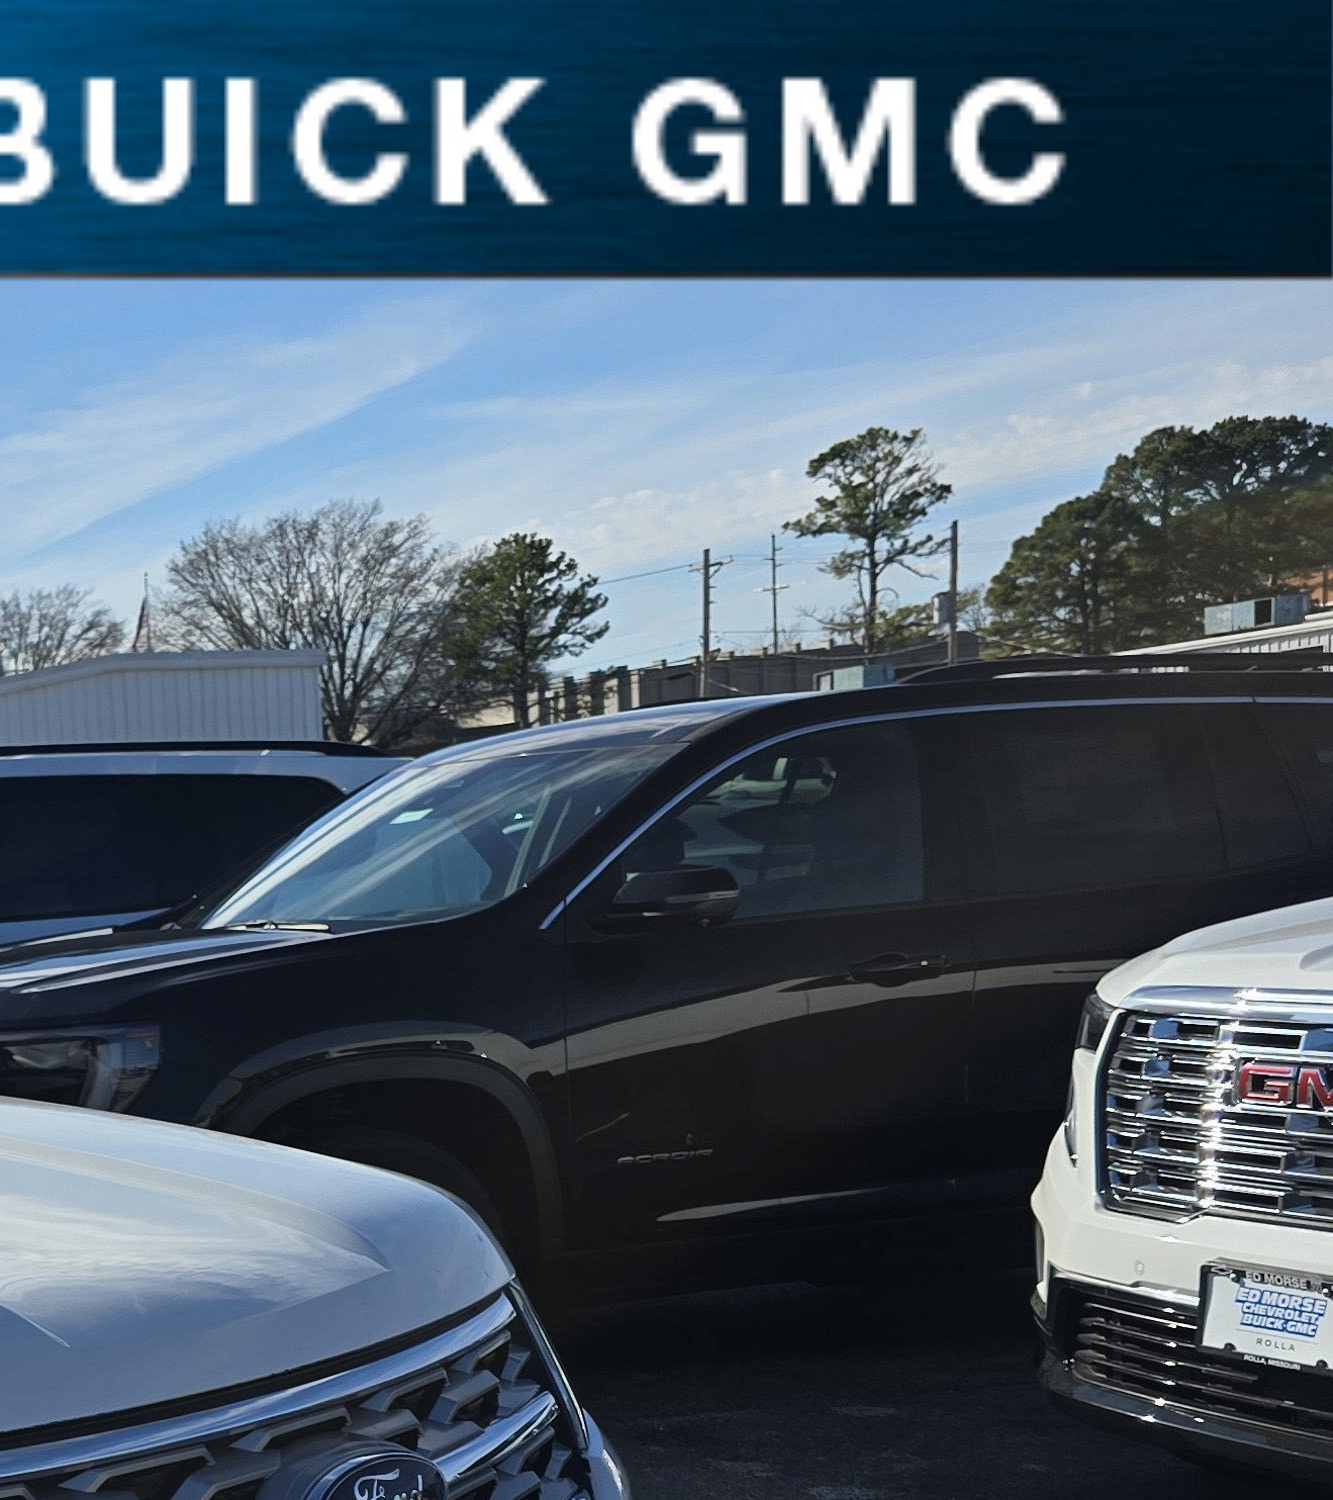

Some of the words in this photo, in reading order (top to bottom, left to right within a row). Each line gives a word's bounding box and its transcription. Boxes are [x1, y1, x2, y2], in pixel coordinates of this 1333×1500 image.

[1245, 1269, 1262, 1283] ED
[1263, 1273, 1308, 1291] MORSE
[1236, 1286, 1262, 1303] ED
[1261, 1290, 1328, 1315] MORSE
[1242, 1301, 1320, 1324] CHEVROLET
[1255, 1337, 1295, 1352] ROLLA
